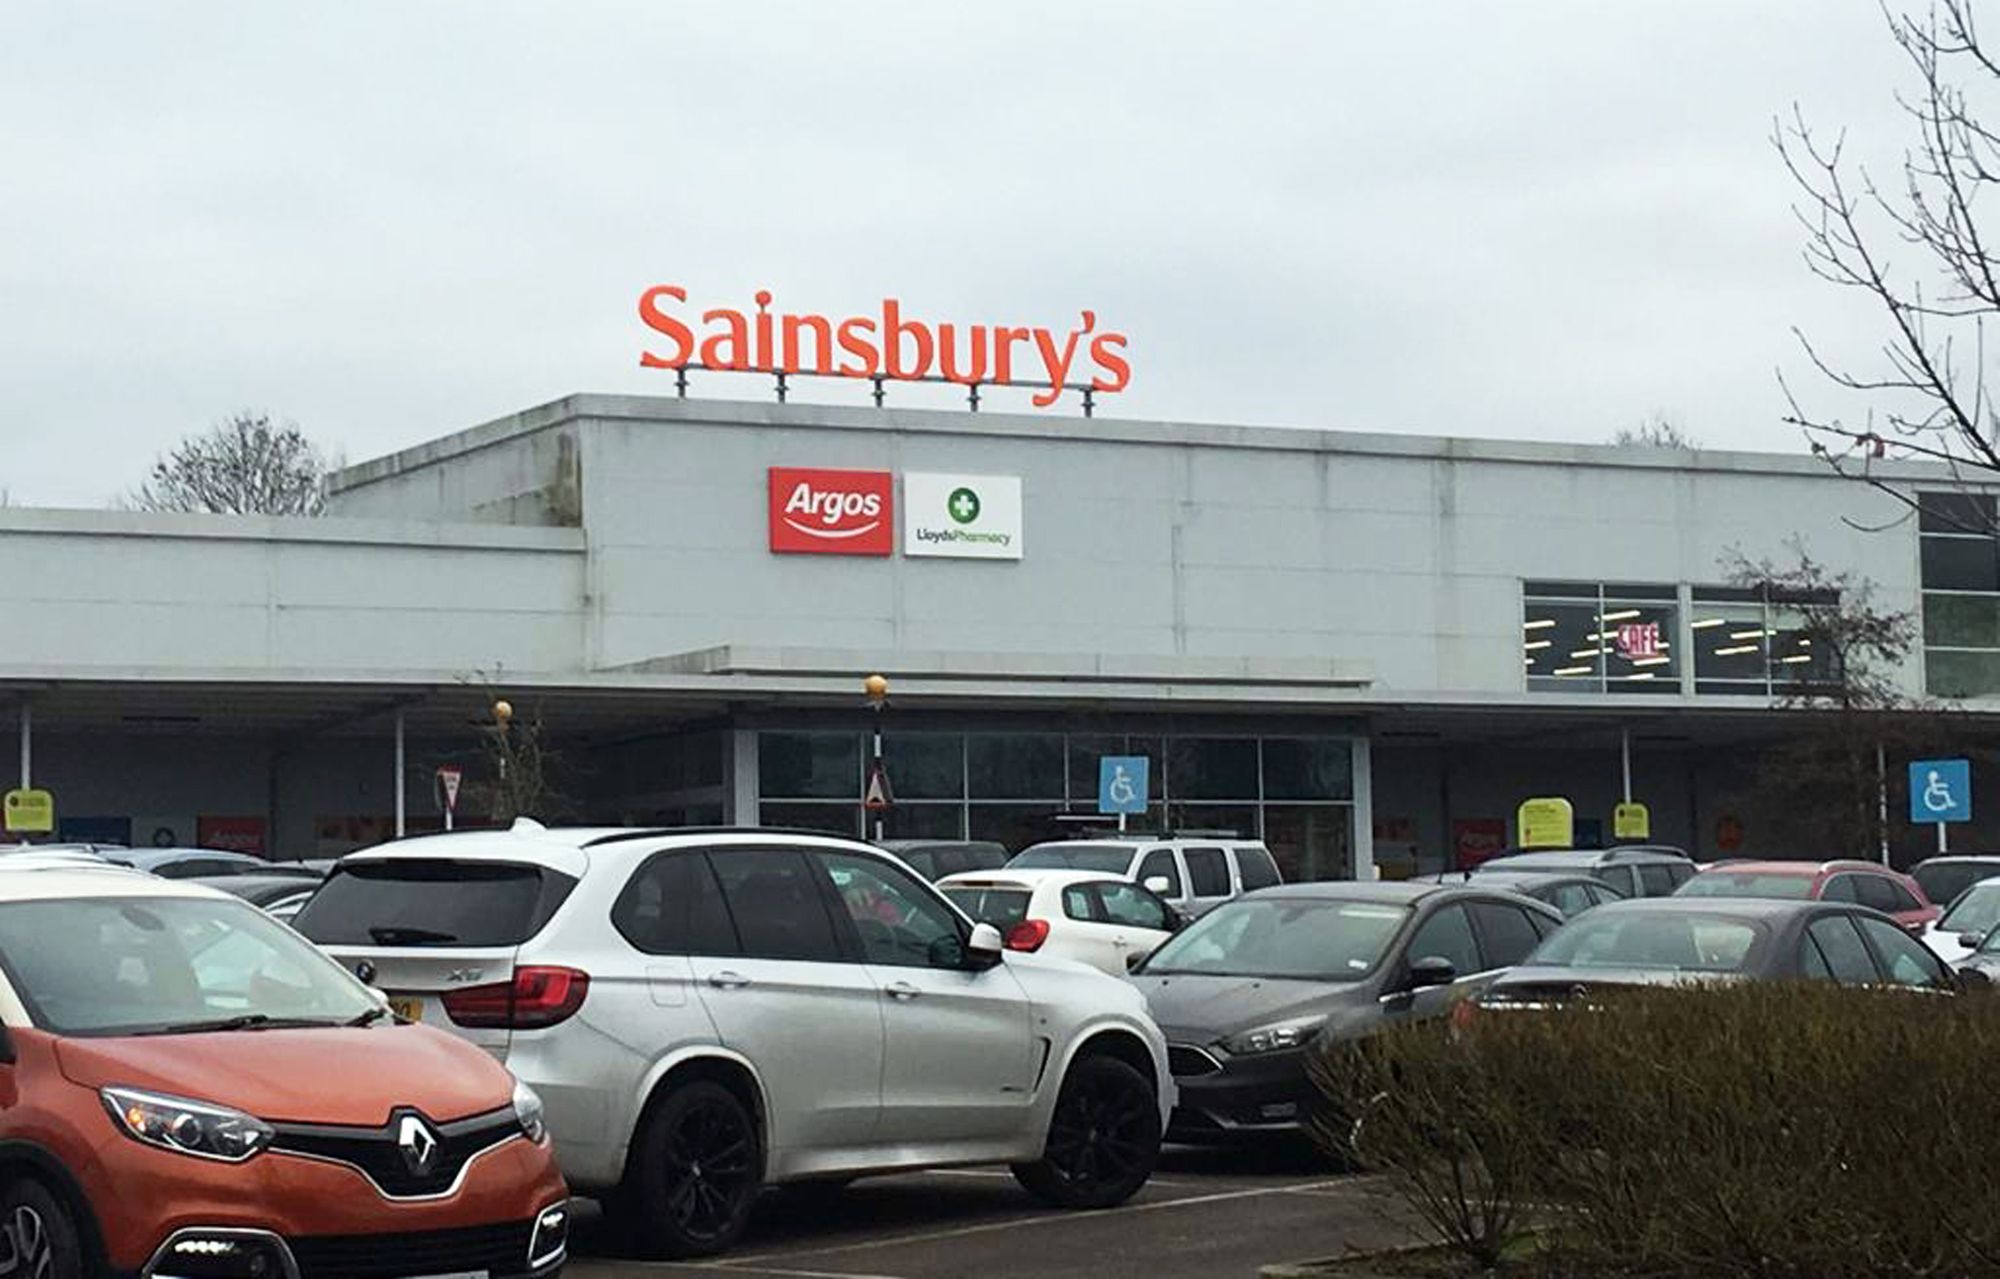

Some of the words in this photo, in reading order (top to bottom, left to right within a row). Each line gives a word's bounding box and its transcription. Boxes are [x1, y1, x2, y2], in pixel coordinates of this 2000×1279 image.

[638, 285, 1131, 407] Sainsbury's
[784, 482, 881, 524] Argos
[916, 528, 1011, 546] LloydsPharmacy
